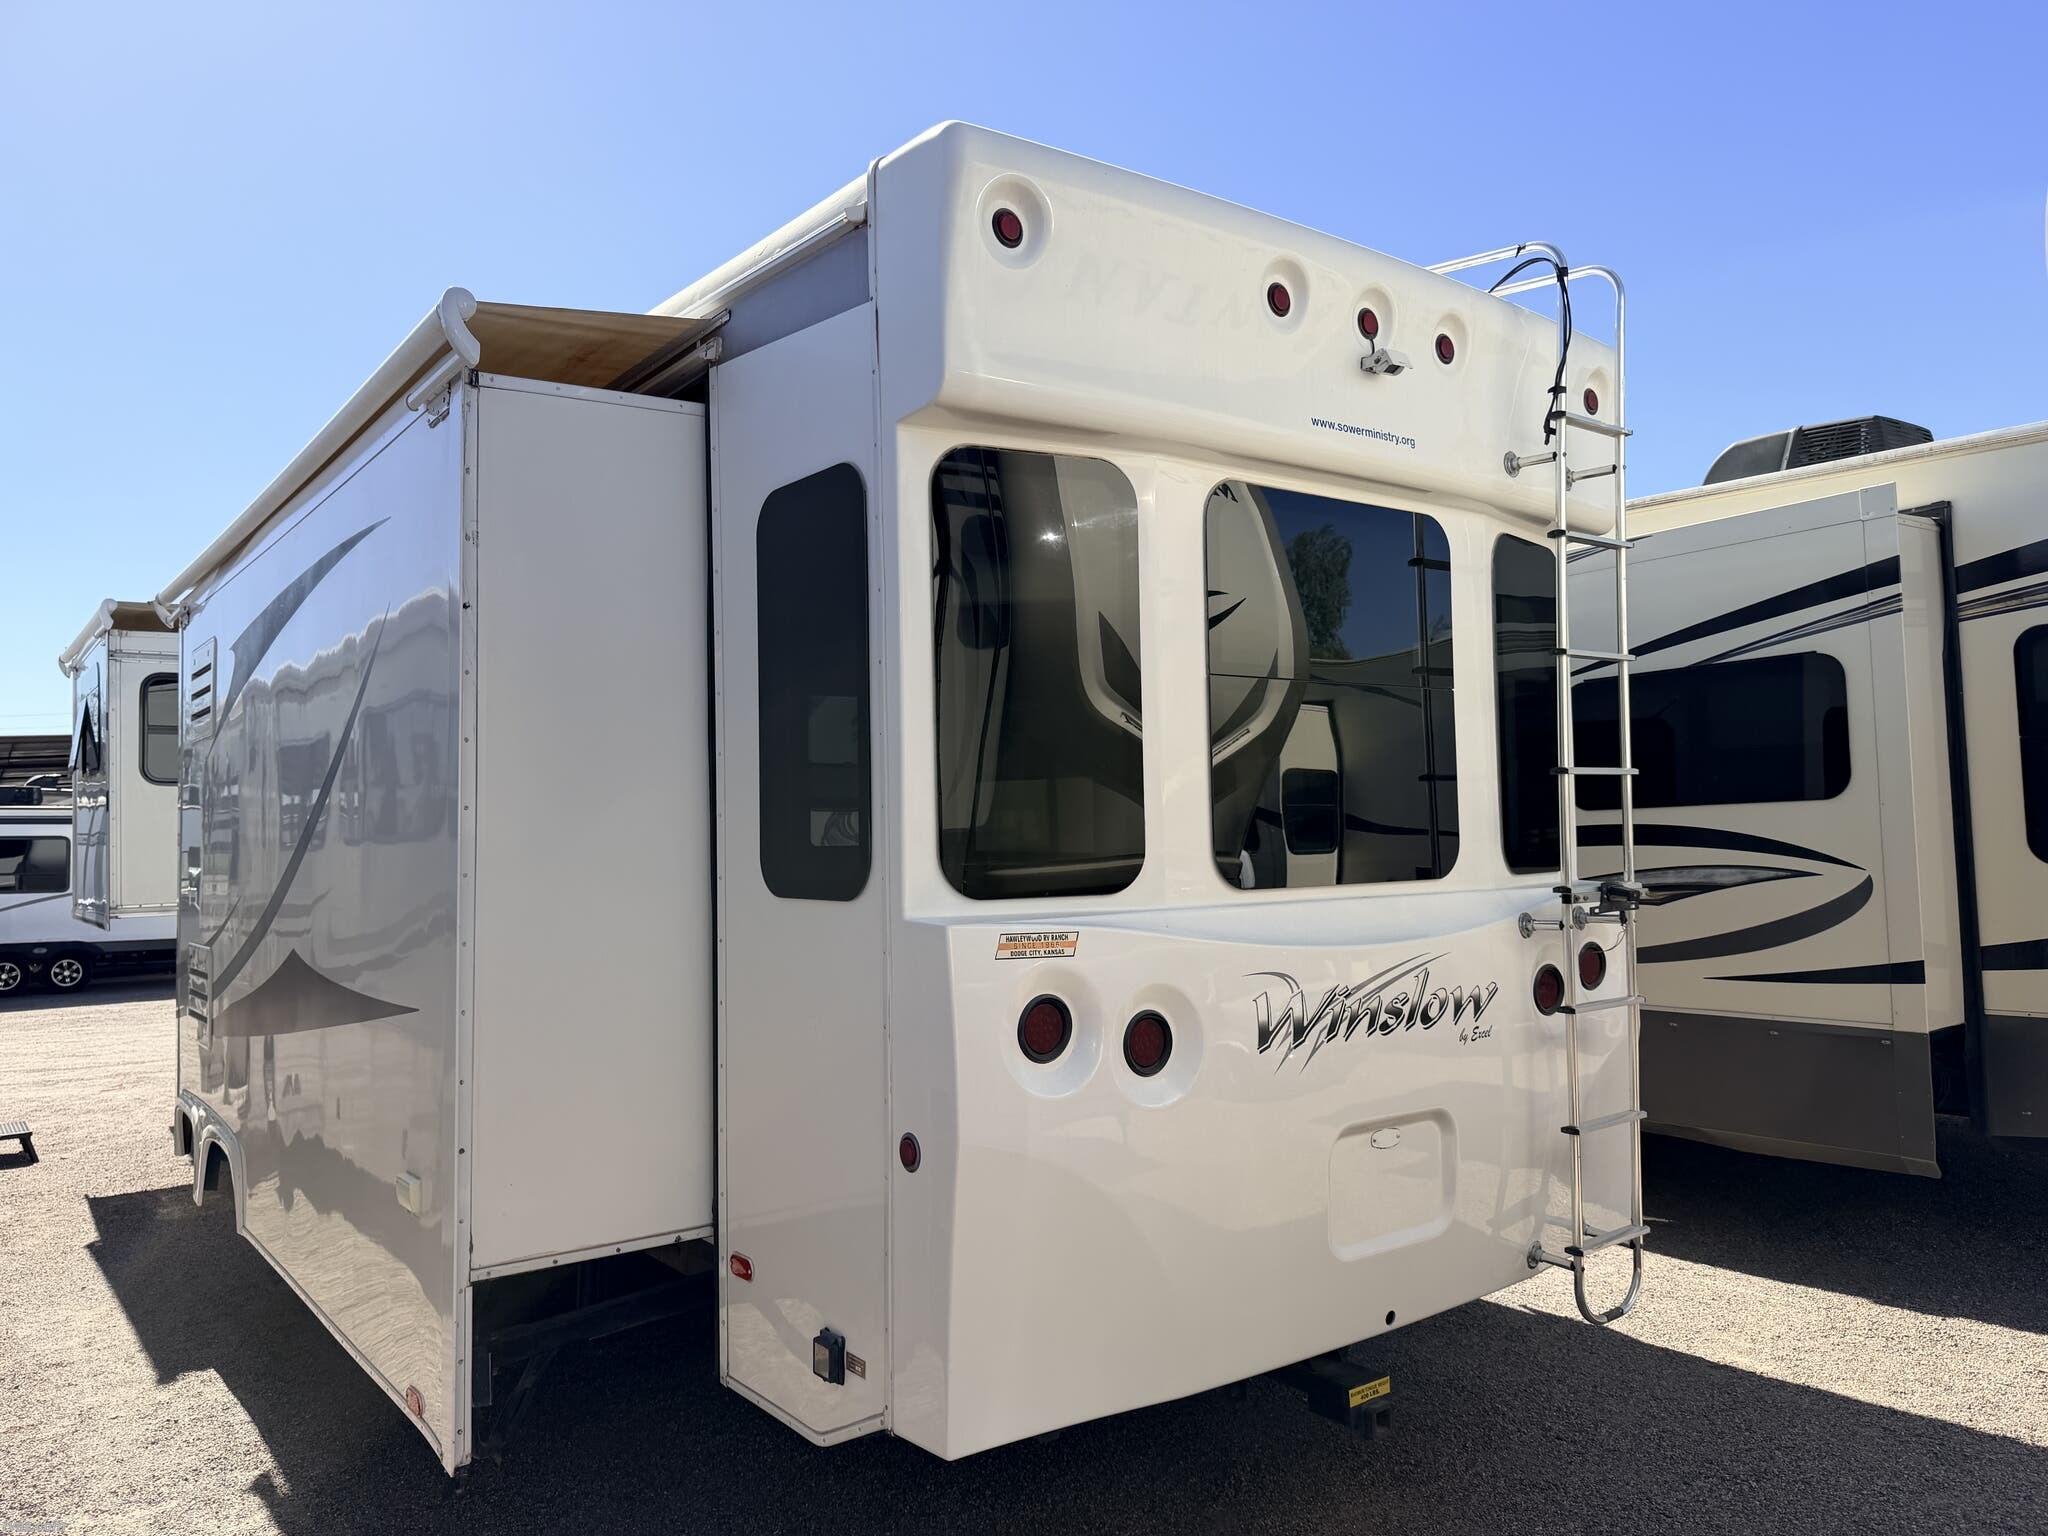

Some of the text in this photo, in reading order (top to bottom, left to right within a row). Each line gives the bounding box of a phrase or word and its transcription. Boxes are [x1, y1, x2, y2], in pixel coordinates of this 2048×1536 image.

[1311, 417, 1416, 449] www.sowerministry.org
[1043, 934, 1050, 942] RV
[1013, 942, 1037, 950] SINCE
[1043, 948, 1065, 956] KANSAS
[1251, 967, 1498, 1054] Winslow
[1458, 1024, 1493, 1046] by Excel
